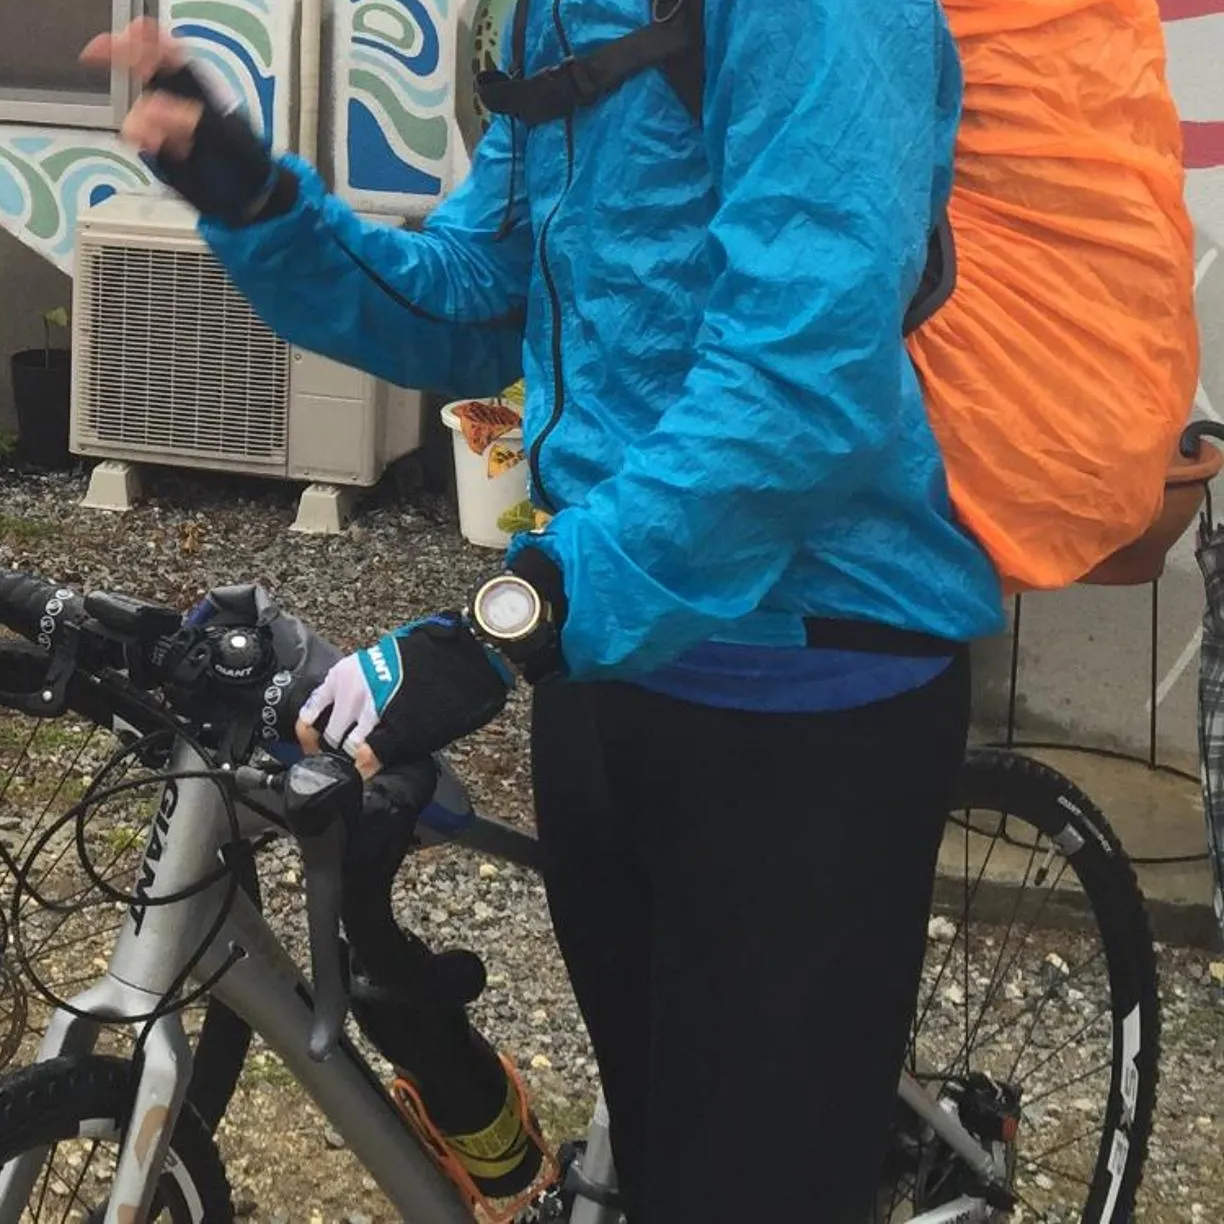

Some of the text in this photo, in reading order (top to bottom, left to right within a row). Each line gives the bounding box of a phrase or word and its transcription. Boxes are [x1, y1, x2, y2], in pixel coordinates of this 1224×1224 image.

[215, 663, 253, 677] GIANT
[367, 645, 393, 682] IANT
[129, 776, 179, 937] GIANT
